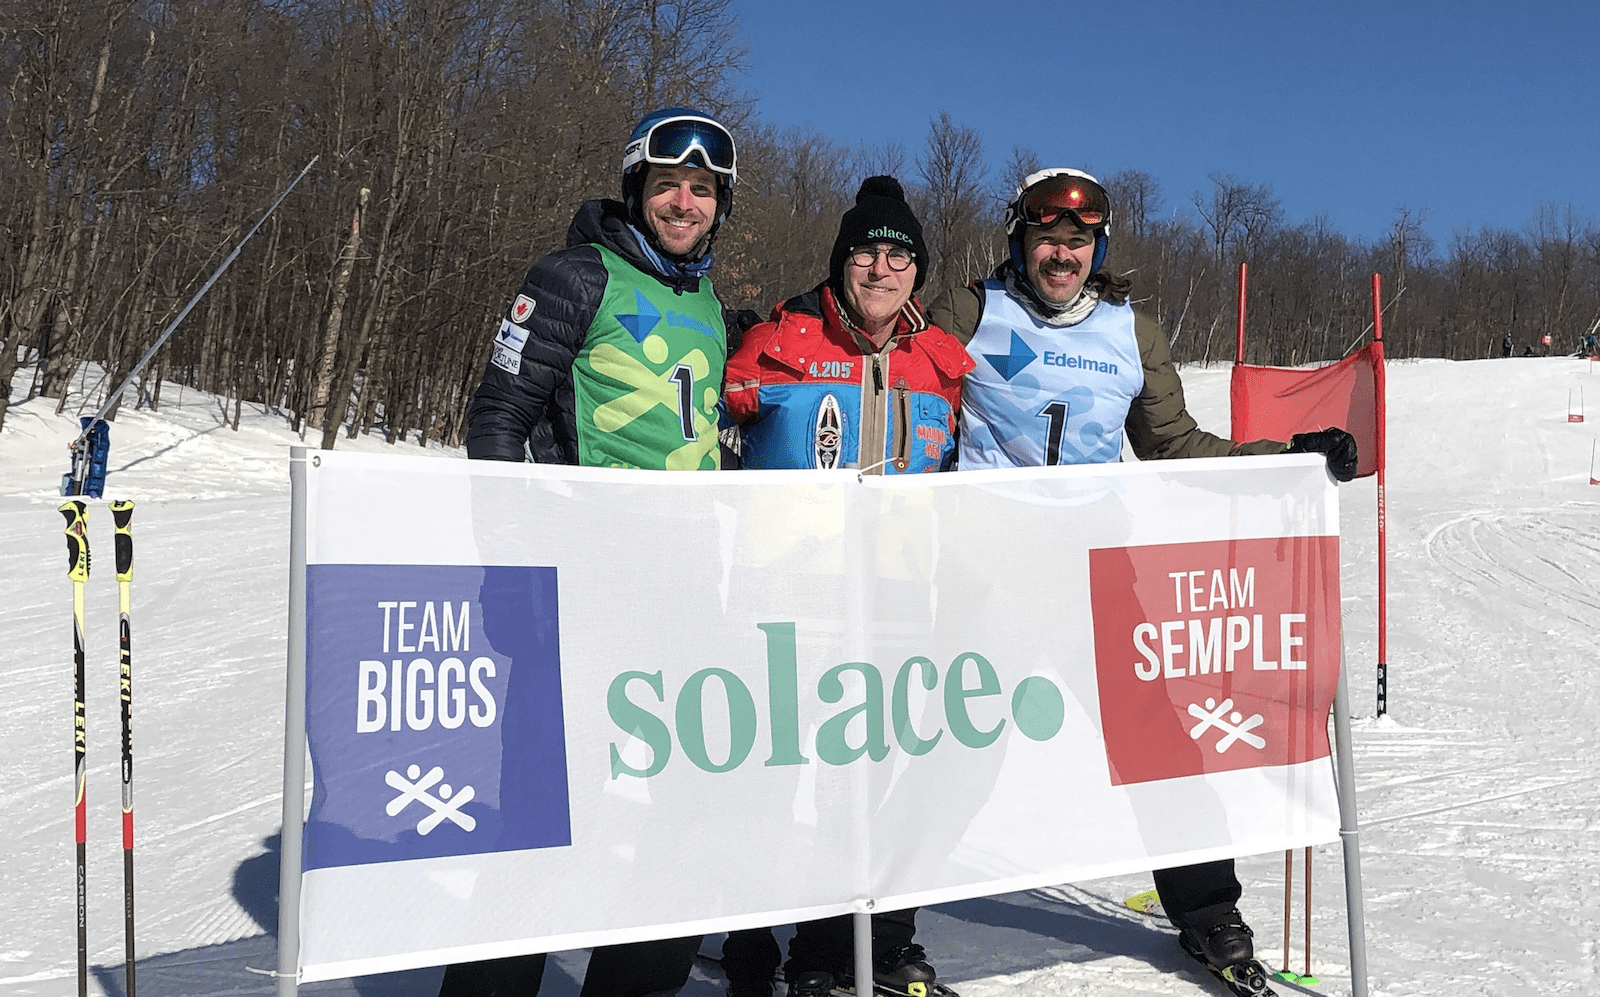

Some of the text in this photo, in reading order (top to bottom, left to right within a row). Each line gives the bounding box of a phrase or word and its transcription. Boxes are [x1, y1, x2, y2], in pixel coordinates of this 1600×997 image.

[1043, 351, 1118, 376] Edelman
[668, 363, 698, 442] 1
[1035, 399, 1070, 466] 1
[78, 551, 86, 577] LEKI
[1168, 567, 1255, 614] TEAM
[377, 600, 471, 653] TEAM
[1132, 613, 1307, 682] SEMPLE
[120, 648, 131, 702] LEKI
[356, 656, 497, 733] BIGGS
[75, 701, 85, 752] LEKI
